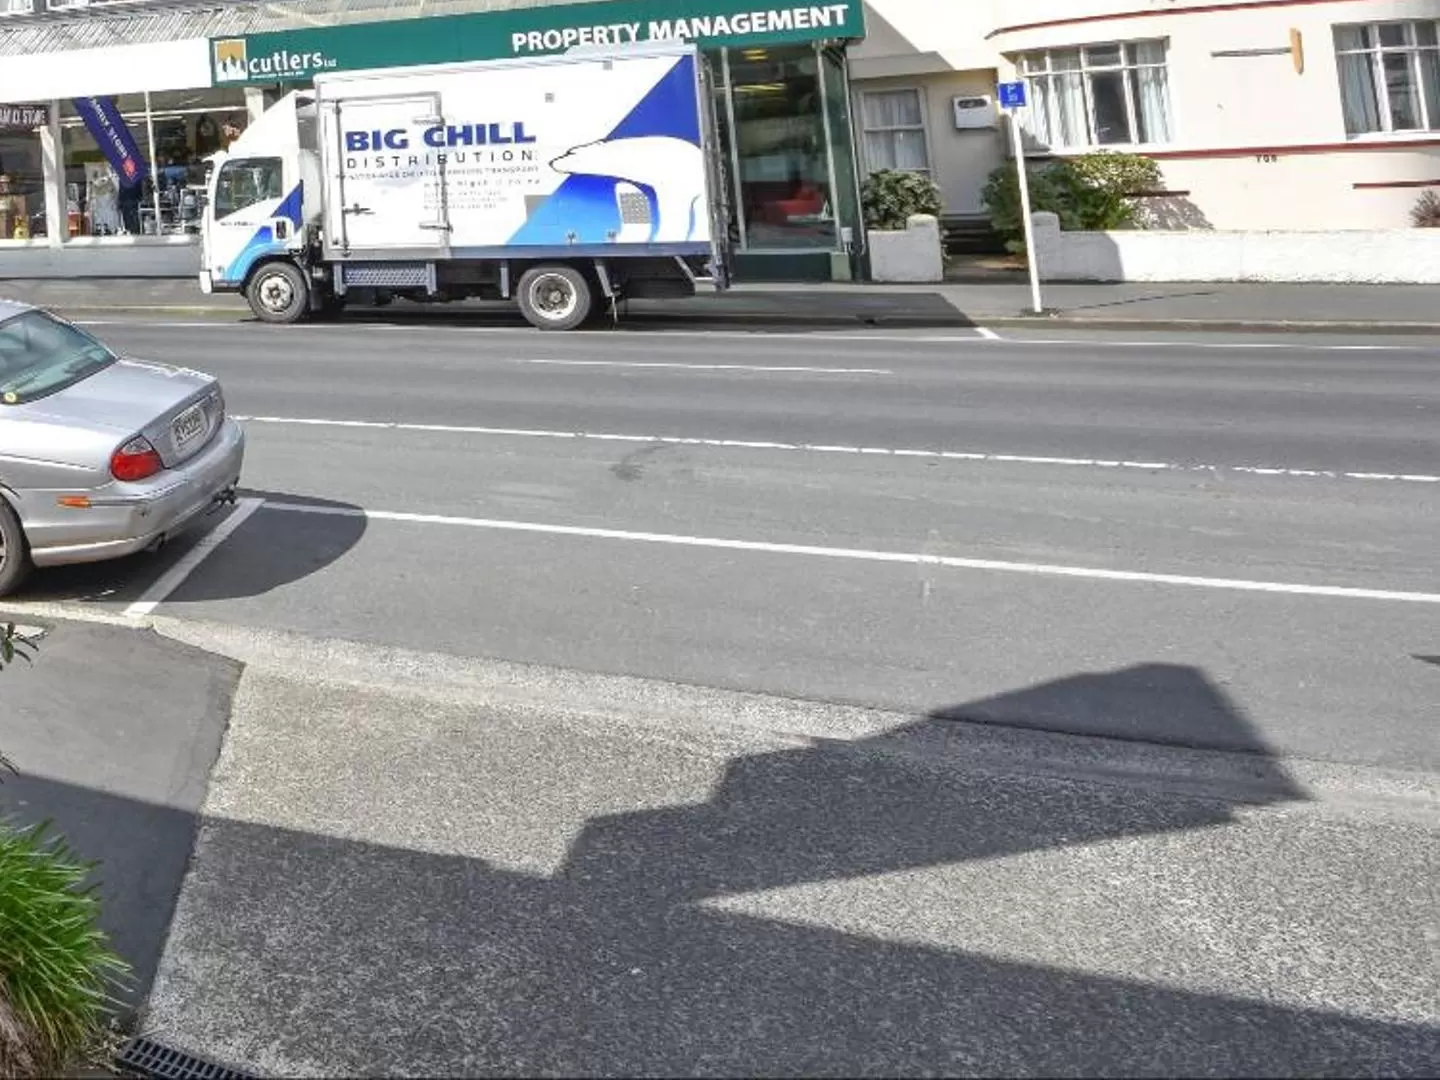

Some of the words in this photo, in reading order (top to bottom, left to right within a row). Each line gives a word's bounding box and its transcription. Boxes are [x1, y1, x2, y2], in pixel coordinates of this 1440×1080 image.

[512, 24, 640, 52] PROPERTY
[648, 4, 849, 41] MANAGEMENT
[249, 50, 323, 73] cutlers
[346, 129, 409, 152] BIG
[423, 121, 536, 147] CHILL
[347, 150, 533, 169] DISTRIBUTION
